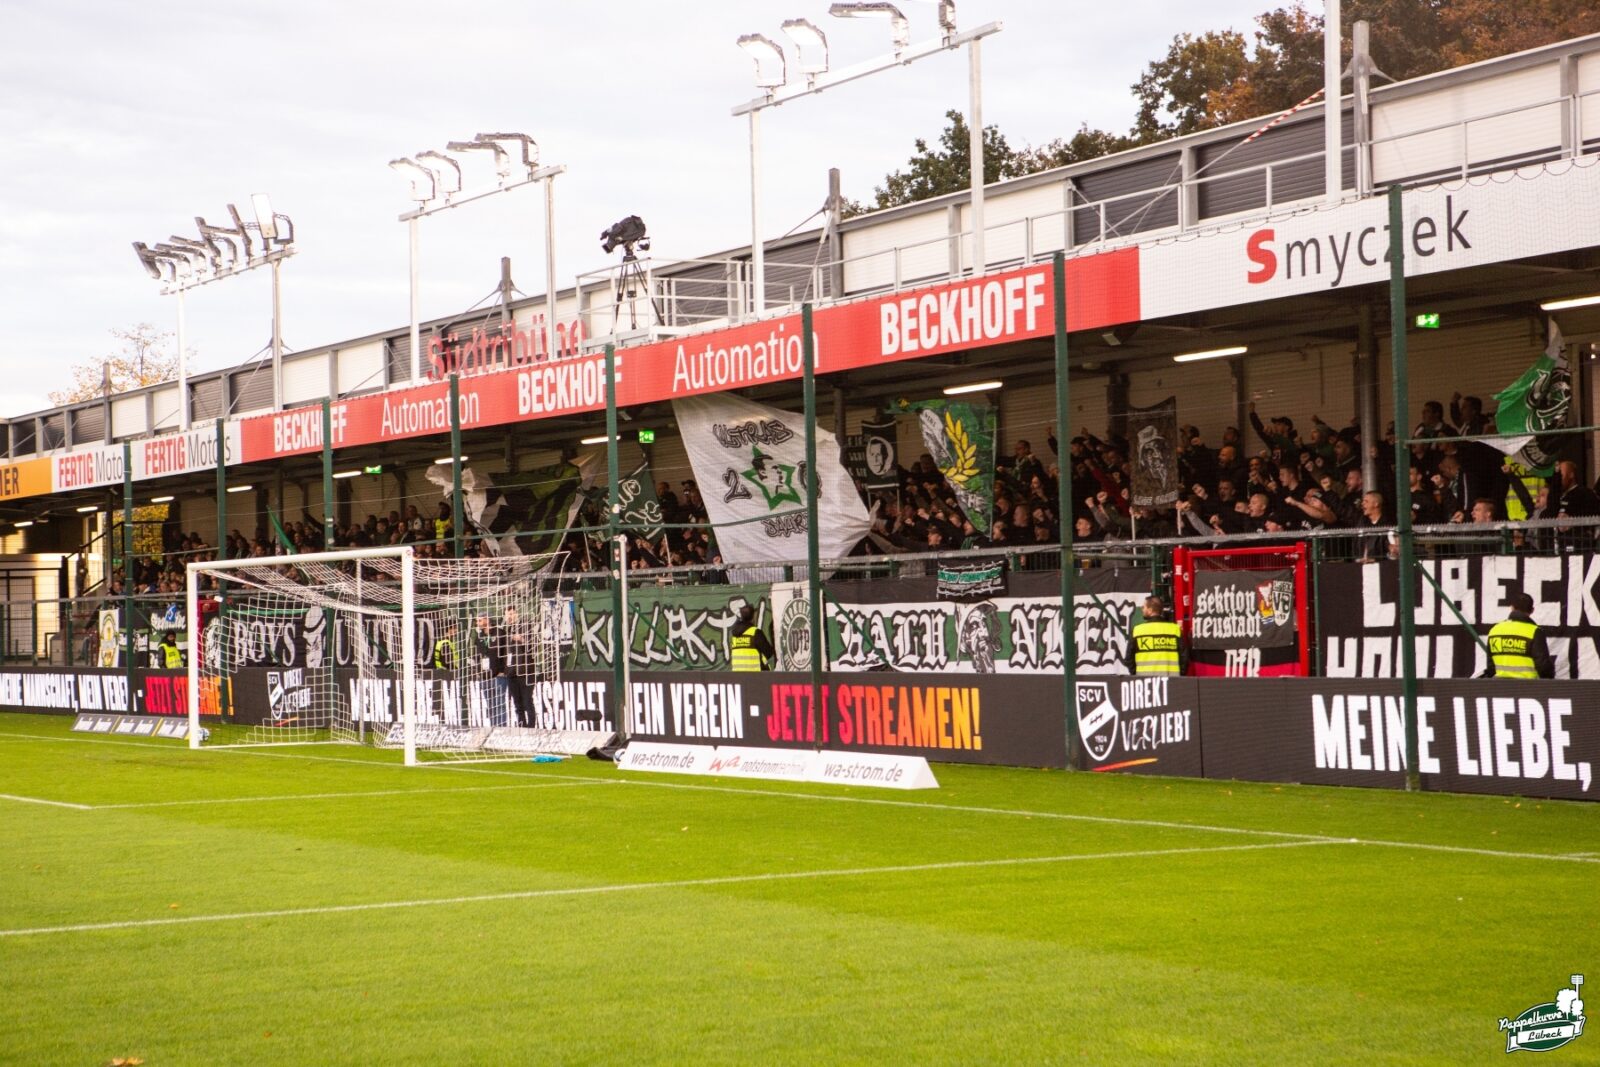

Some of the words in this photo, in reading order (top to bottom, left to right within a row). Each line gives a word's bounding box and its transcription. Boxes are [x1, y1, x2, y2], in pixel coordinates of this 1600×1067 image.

[880, 272, 1045, 356] BECKHOFF
[381, 391, 480, 437] Automaton
[58, 453, 93, 488] FERTIG
[95, 451, 124, 482] Moto
[144, 436, 185, 476] FERTIG
[188, 434, 231, 469] Motos
[335, 617, 435, 666] UNITD
[1080, 689, 1102, 702] SCV
[1121, 677, 1168, 711] DIREKT
[670, 684, 743, 738] VEREIN
[838, 685, 982, 750] STREAMEN!
[1121, 710, 1191, 751] VERLIEBT
[631, 751, 695, 769] wa-strom.de
[1312, 694, 1440, 774] MEINE
[1453, 697, 1591, 792] LIEBE,
[824, 761, 903, 782] wa-strom.de
